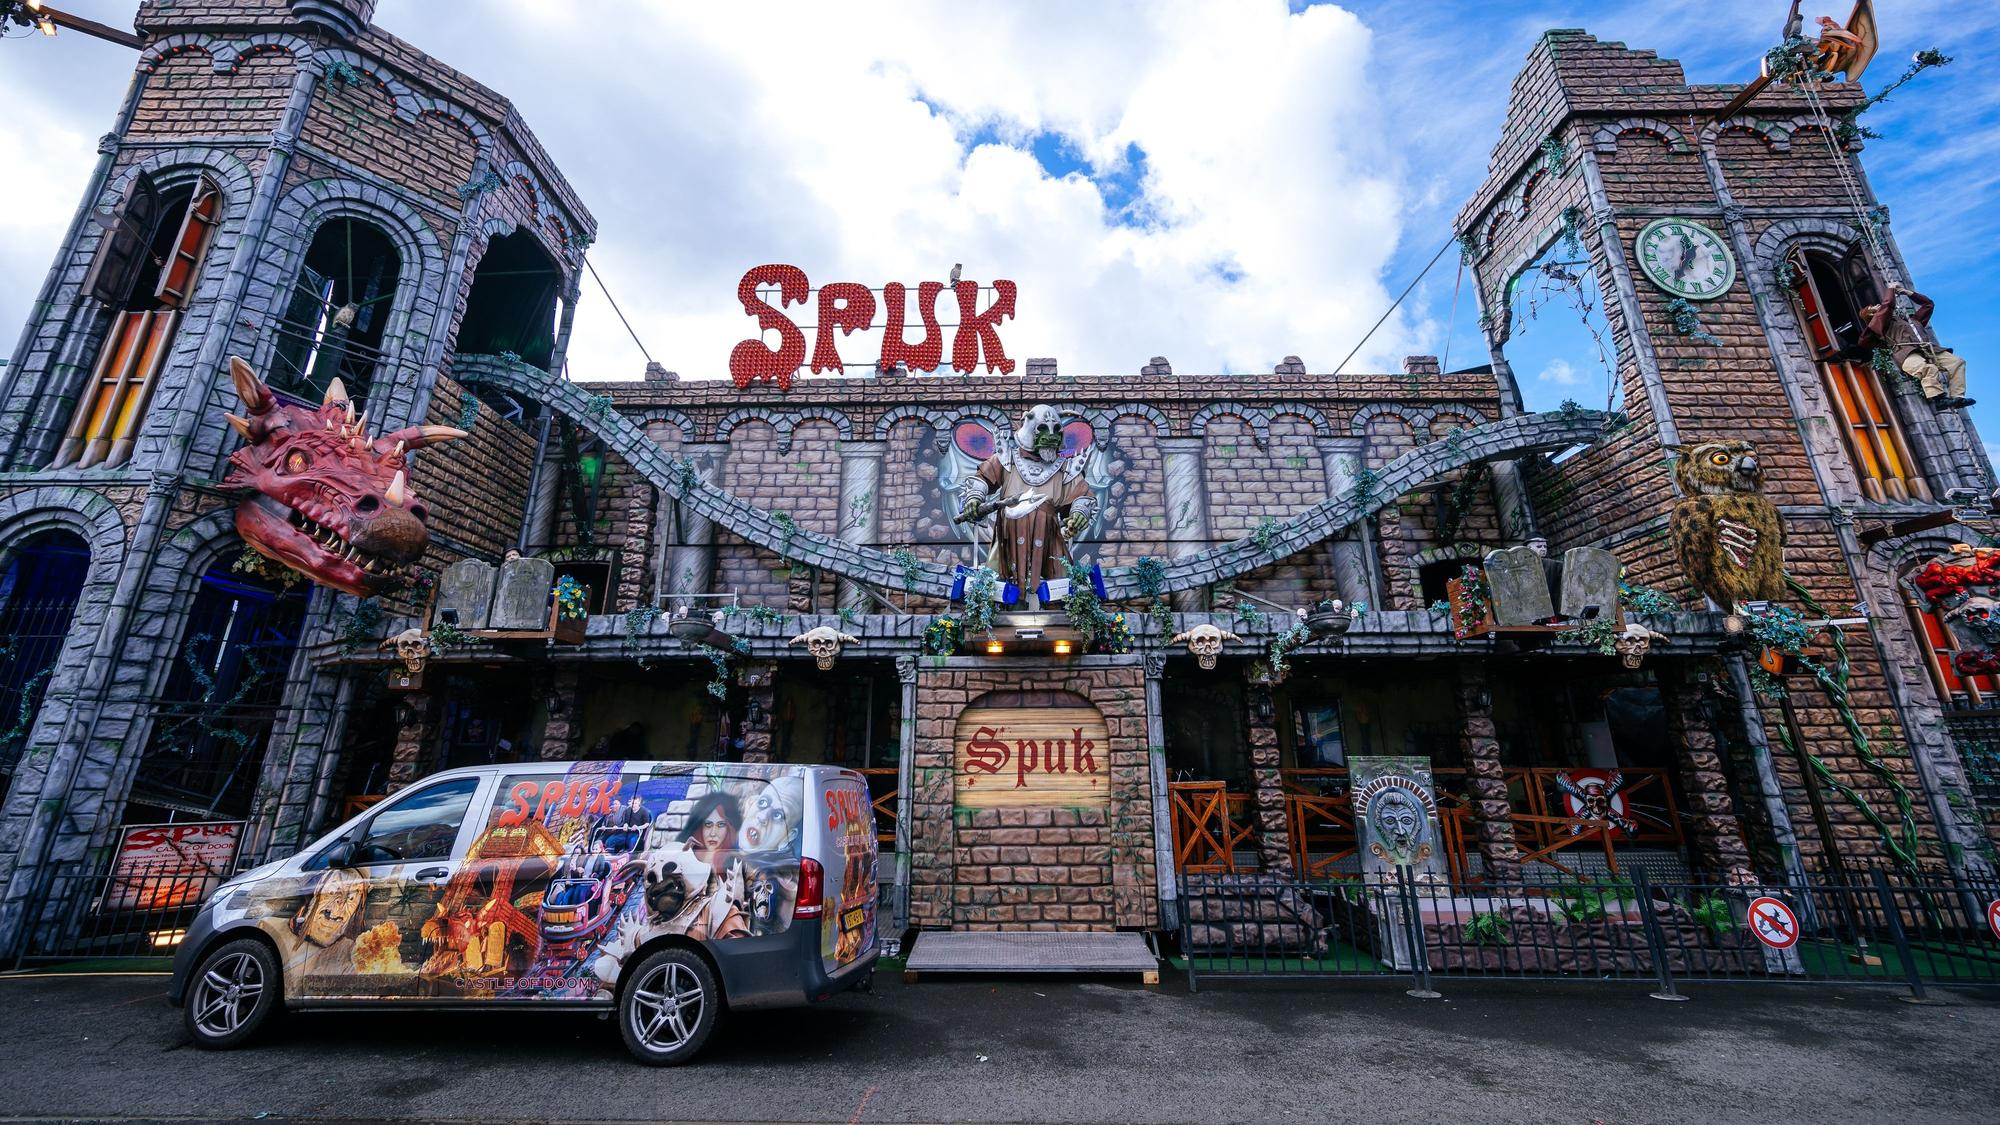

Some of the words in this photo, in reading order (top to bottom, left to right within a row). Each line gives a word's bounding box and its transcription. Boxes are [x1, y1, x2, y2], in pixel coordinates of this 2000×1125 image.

[729, 264, 1017, 390] SPUK
[963, 726, 1098, 789] Spuk
[498, 780, 623, 828] SPUK
[454, 976, 516, 990] CASTLE
[518, 976, 541, 989] OF
[543, 976, 593, 989] DOOM
